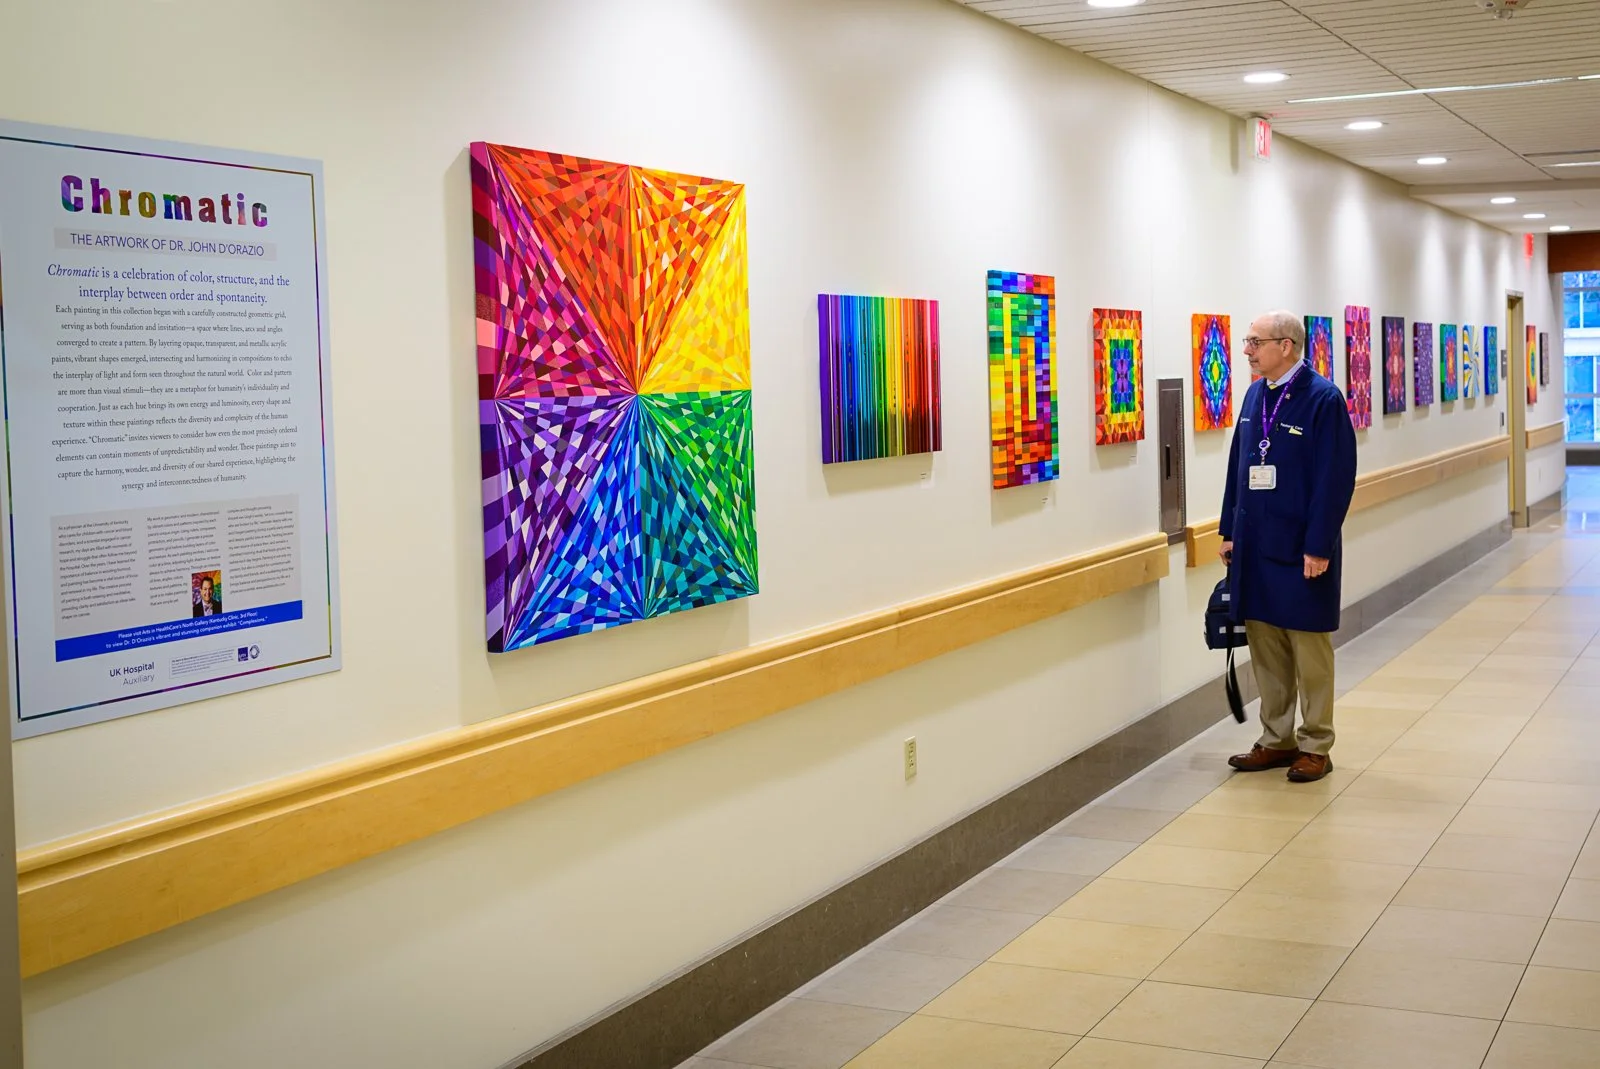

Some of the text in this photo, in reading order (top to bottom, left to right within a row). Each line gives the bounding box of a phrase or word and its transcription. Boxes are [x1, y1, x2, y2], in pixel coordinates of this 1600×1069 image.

[61, 175, 268, 227] Chromatic
[70, 233, 264, 256] THE ARTWORK OF DR. JOHN D'ORAZIO
[47, 264, 99, 277] Chromatic
[102, 267, 109, 278] is
[121, 268, 174, 281] celebration
[177, 270, 188, 281] of
[189, 271, 214, 284] color,
[216, 273, 257, 286] structure,
[259, 274, 274, 285] and
[276, 274, 289, 286] the
[79, 286, 267, 306] interplay between order and spontaneity.
[55, 305, 71, 313] Each
[73, 306, 100, 316] painting
[109, 306, 121, 314] this
[153, 307, 170, 317] began
[191, 308, 215, 318] carefully
[60, 322, 84, 331] serving
[110, 322, 143, 330] foundation
[196, 325, 211, 333] space
[56, 338, 89, 347] converged
[149, 338, 157, 348] By
[158, 338, 181, 348] layering
[74, 354, 96, 362] vibrant
[98, 354, 119, 364] shapes
[149, 354, 183, 363] intersecting
[196, 354, 230, 363] harmonizing
[65, 370, 93, 380] interplay
[95, 370, 103, 378] of
[103, 370, 117, 380] light
[163, 369, 195, 379] throughout
[103, 386, 121, 394] visual
[179, 384, 206, 394] metaphor
[97, 403, 110, 412] Just
[135, 401, 146, 409] hue
[189, 401, 208, 409] energy
[86, 419, 107, 427] within
[109, 418, 125, 426] these
[126, 417, 154, 427] paintings
[155, 416, 176, 424] reflects
[177, 415, 187, 423] the
[188, 415, 211, 424] diversity
[128, 433, 148, 441] invites
[180, 430, 203, 438] consider
[205, 429, 216, 437] how
[55, 453, 83, 461] elements
[123, 449, 150, 457] moments
[160, 445, 204, 457] unpredictability
[206, 444, 216, 452] and
[57, 470, 81, 479] capture
[83, 468, 94, 476] the
[150, 463, 161, 471] and
[162, 462, 186, 471] diversity
[206, 459, 224, 467] shared
[121, 482, 143, 491] synergy
[146, 479, 157, 487] and
[158, 475, 212, 486] interconnectedness
[109, 662, 154, 676] UK Hospital
[122, 675, 154, 685] Auxiliary
